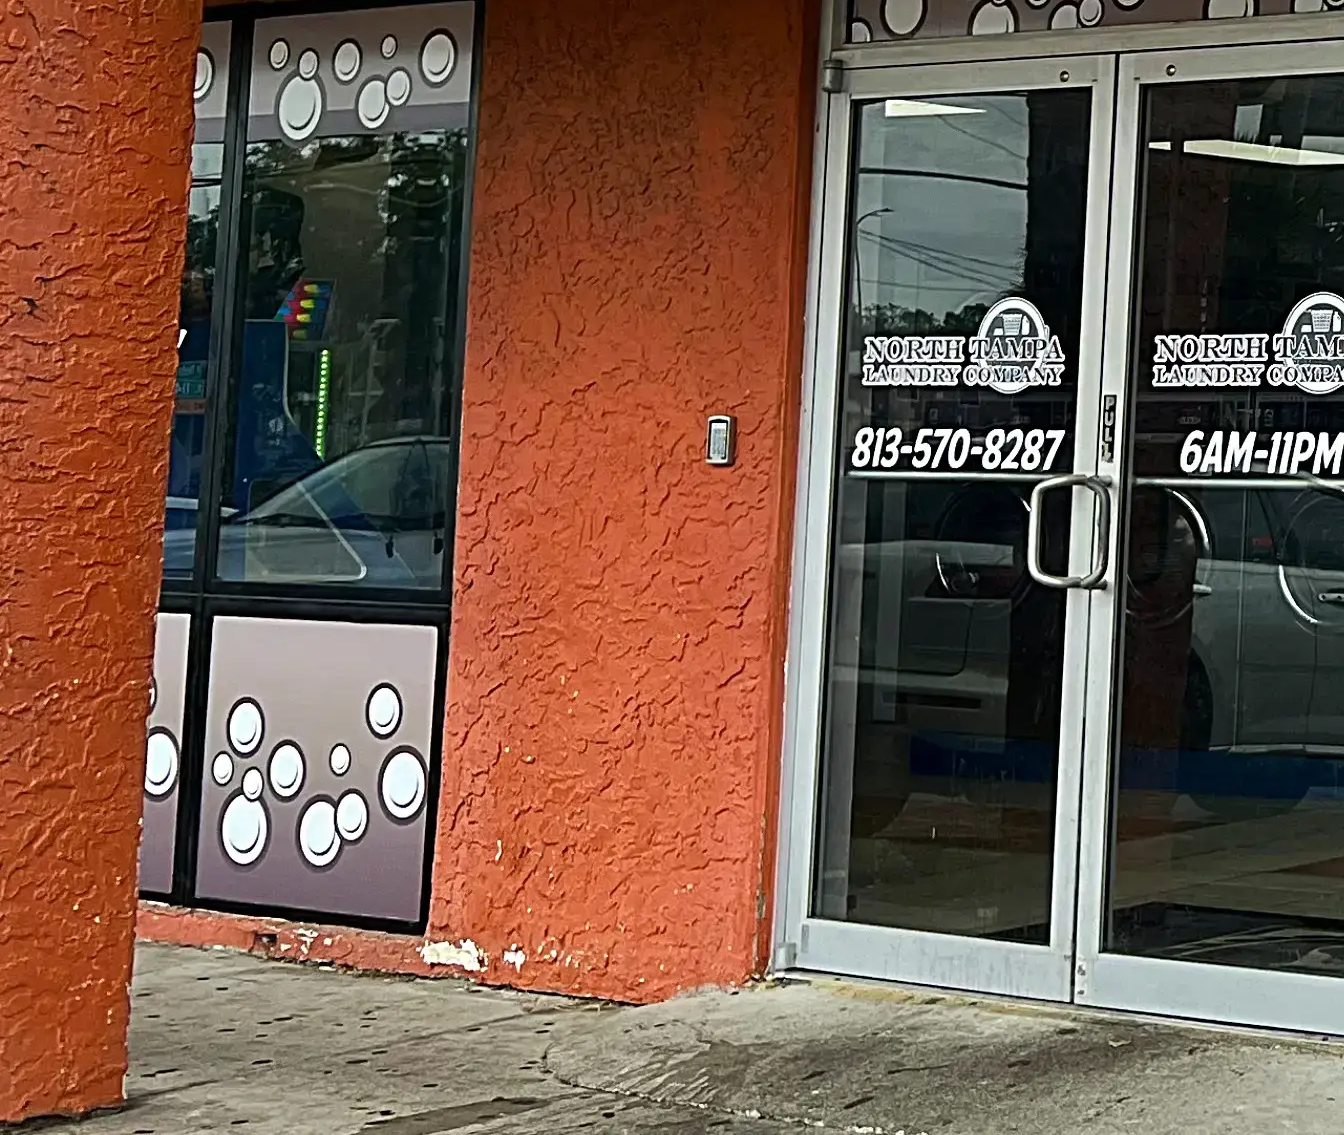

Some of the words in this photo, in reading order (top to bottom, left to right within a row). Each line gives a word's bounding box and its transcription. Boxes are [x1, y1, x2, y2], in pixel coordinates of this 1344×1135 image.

[863, 337, 965, 363] NORTH
[969, 336, 1064, 362] TAMPA
[1153, 334, 1269, 362] NORTH
[862, 364, 961, 386] LAUNDRY
[963, 364, 1065, 386] COMPANY
[1152, 364, 1265, 387] LAUNDRY
[1104, 396, 1115, 460] PULL
[851, 426, 1066, 471] 813-570-8287
